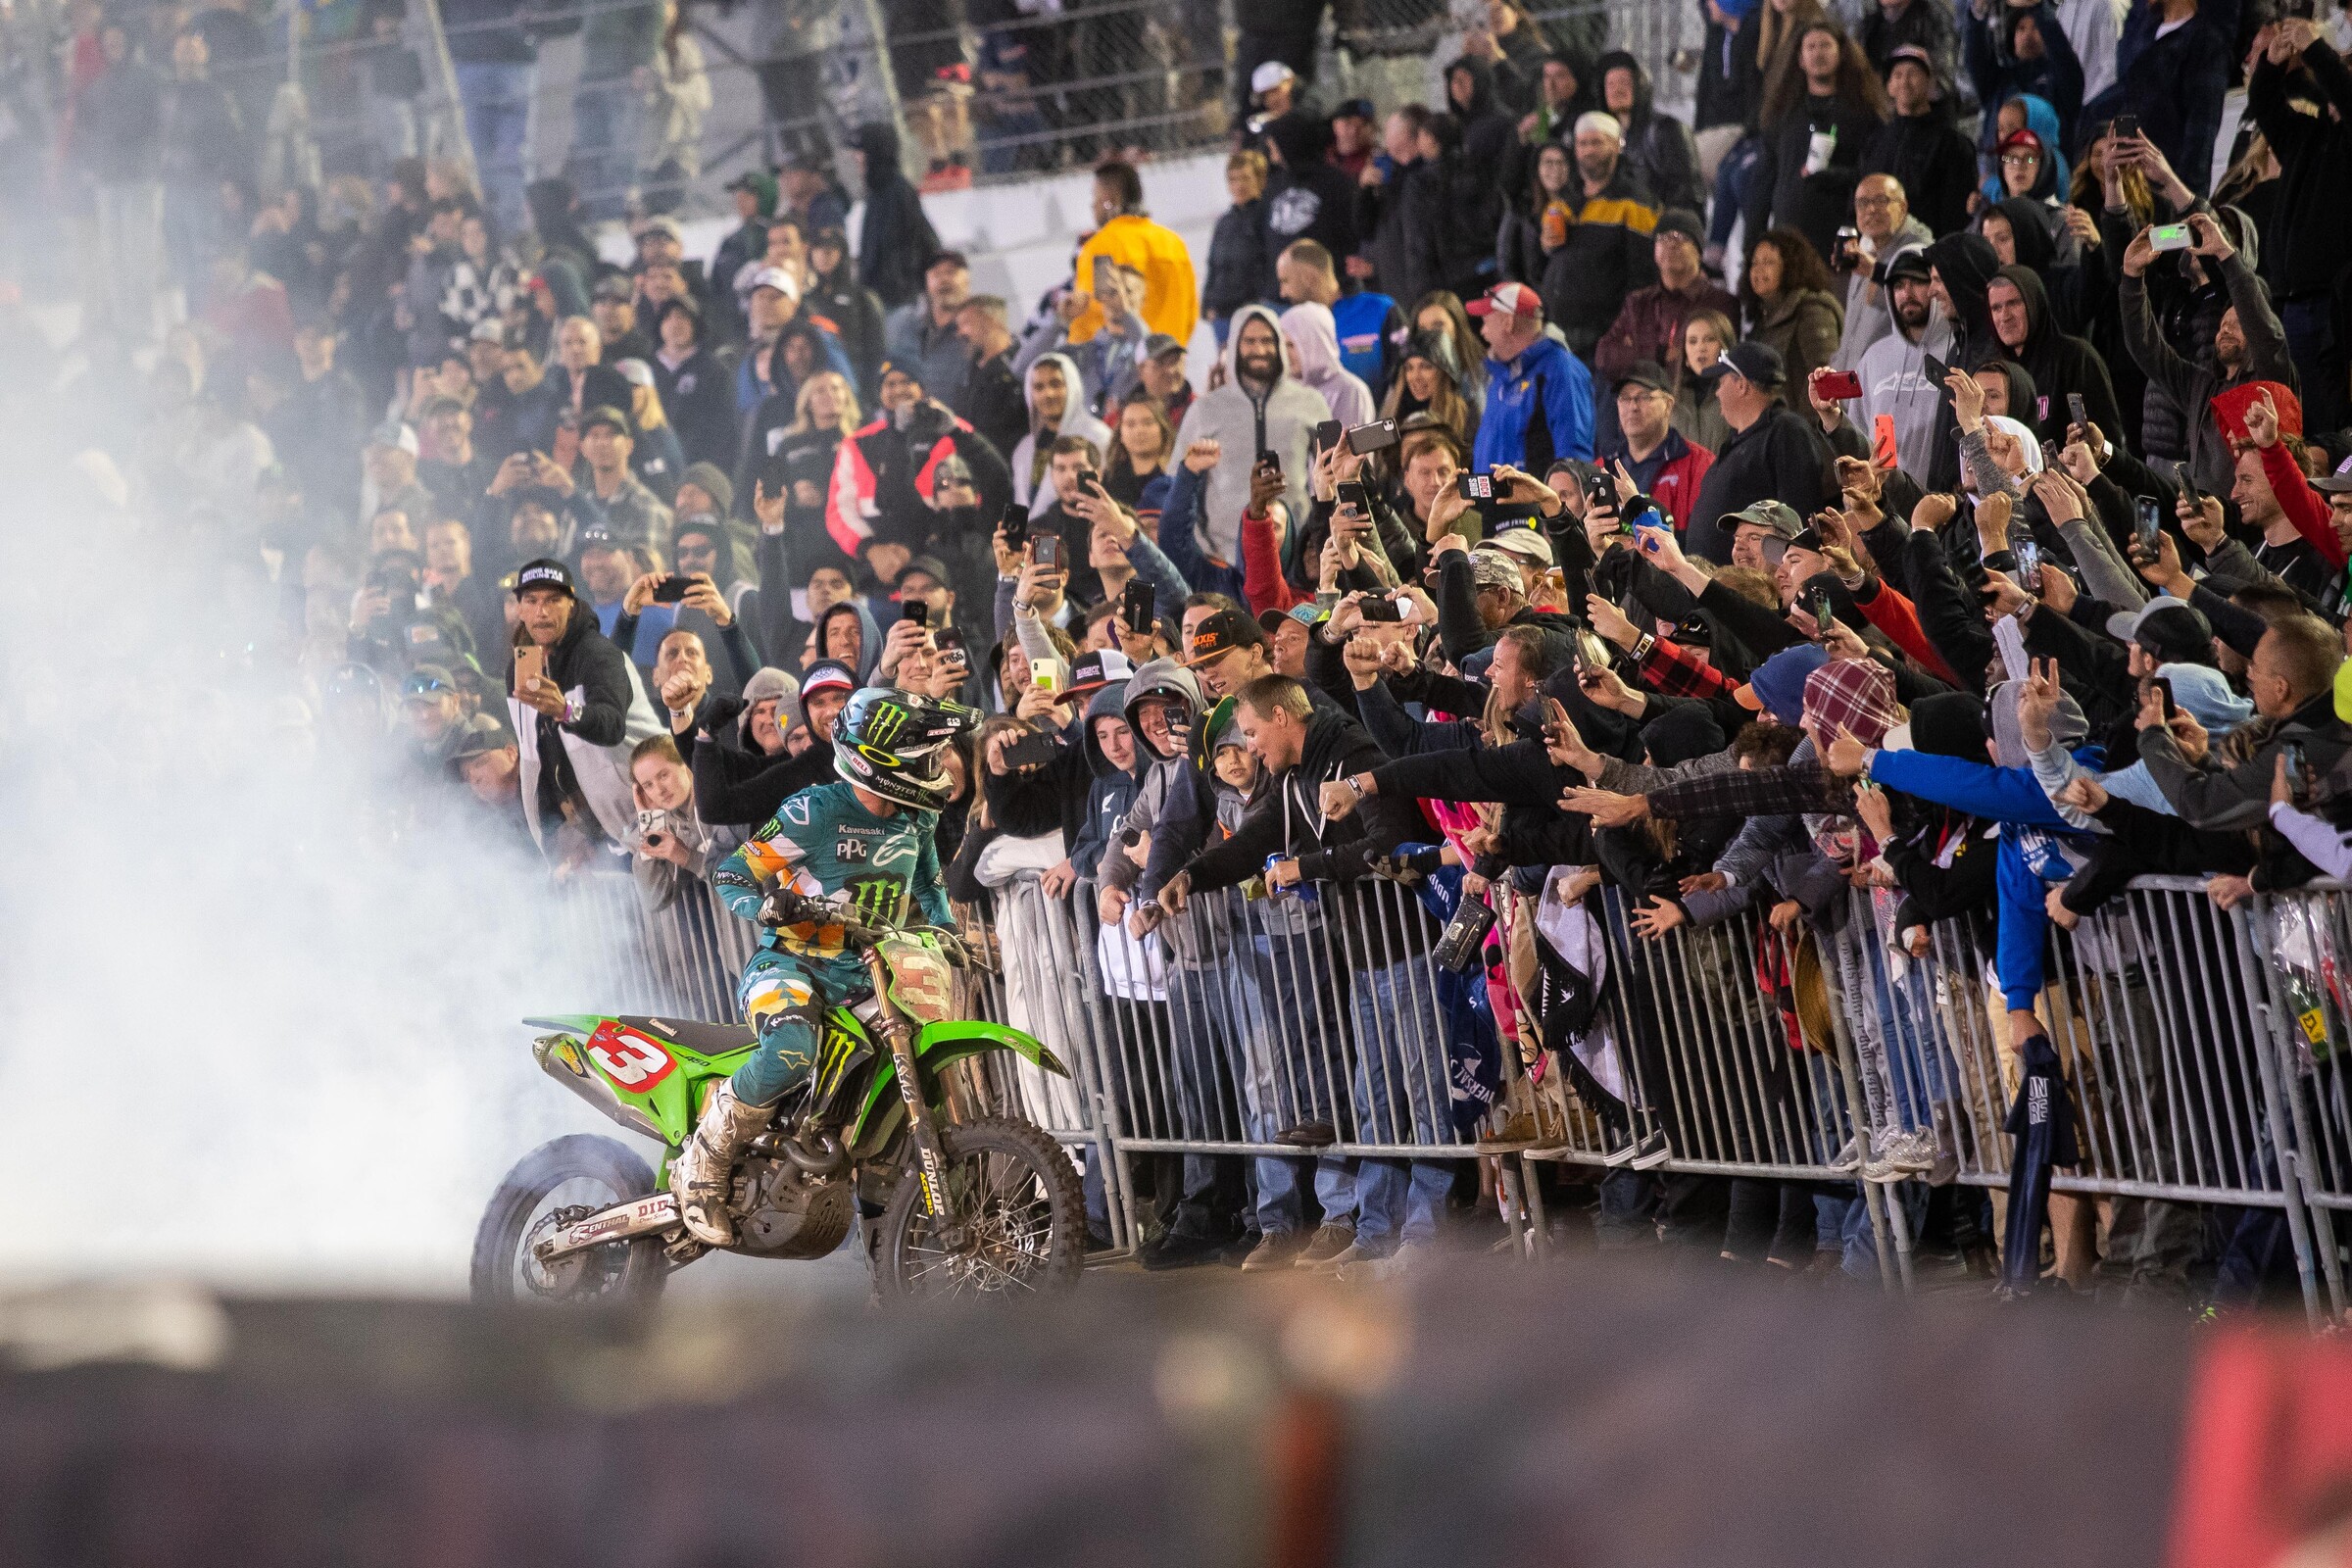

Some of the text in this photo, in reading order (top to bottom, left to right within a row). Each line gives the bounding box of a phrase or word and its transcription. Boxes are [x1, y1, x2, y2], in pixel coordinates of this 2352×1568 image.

[852, 757, 869, 772] BELL
[876, 775, 917, 796] MONSTER
[838, 824, 886, 836] Kawasaki
[837, 839, 867, 859] PPG
[588, 1034, 668, 1085] 3
[893, 1054, 918, 1103] KYB
[919, 1171, 934, 1216] ACERBIS
[920, 1147, 946, 1216] DUNLOP
